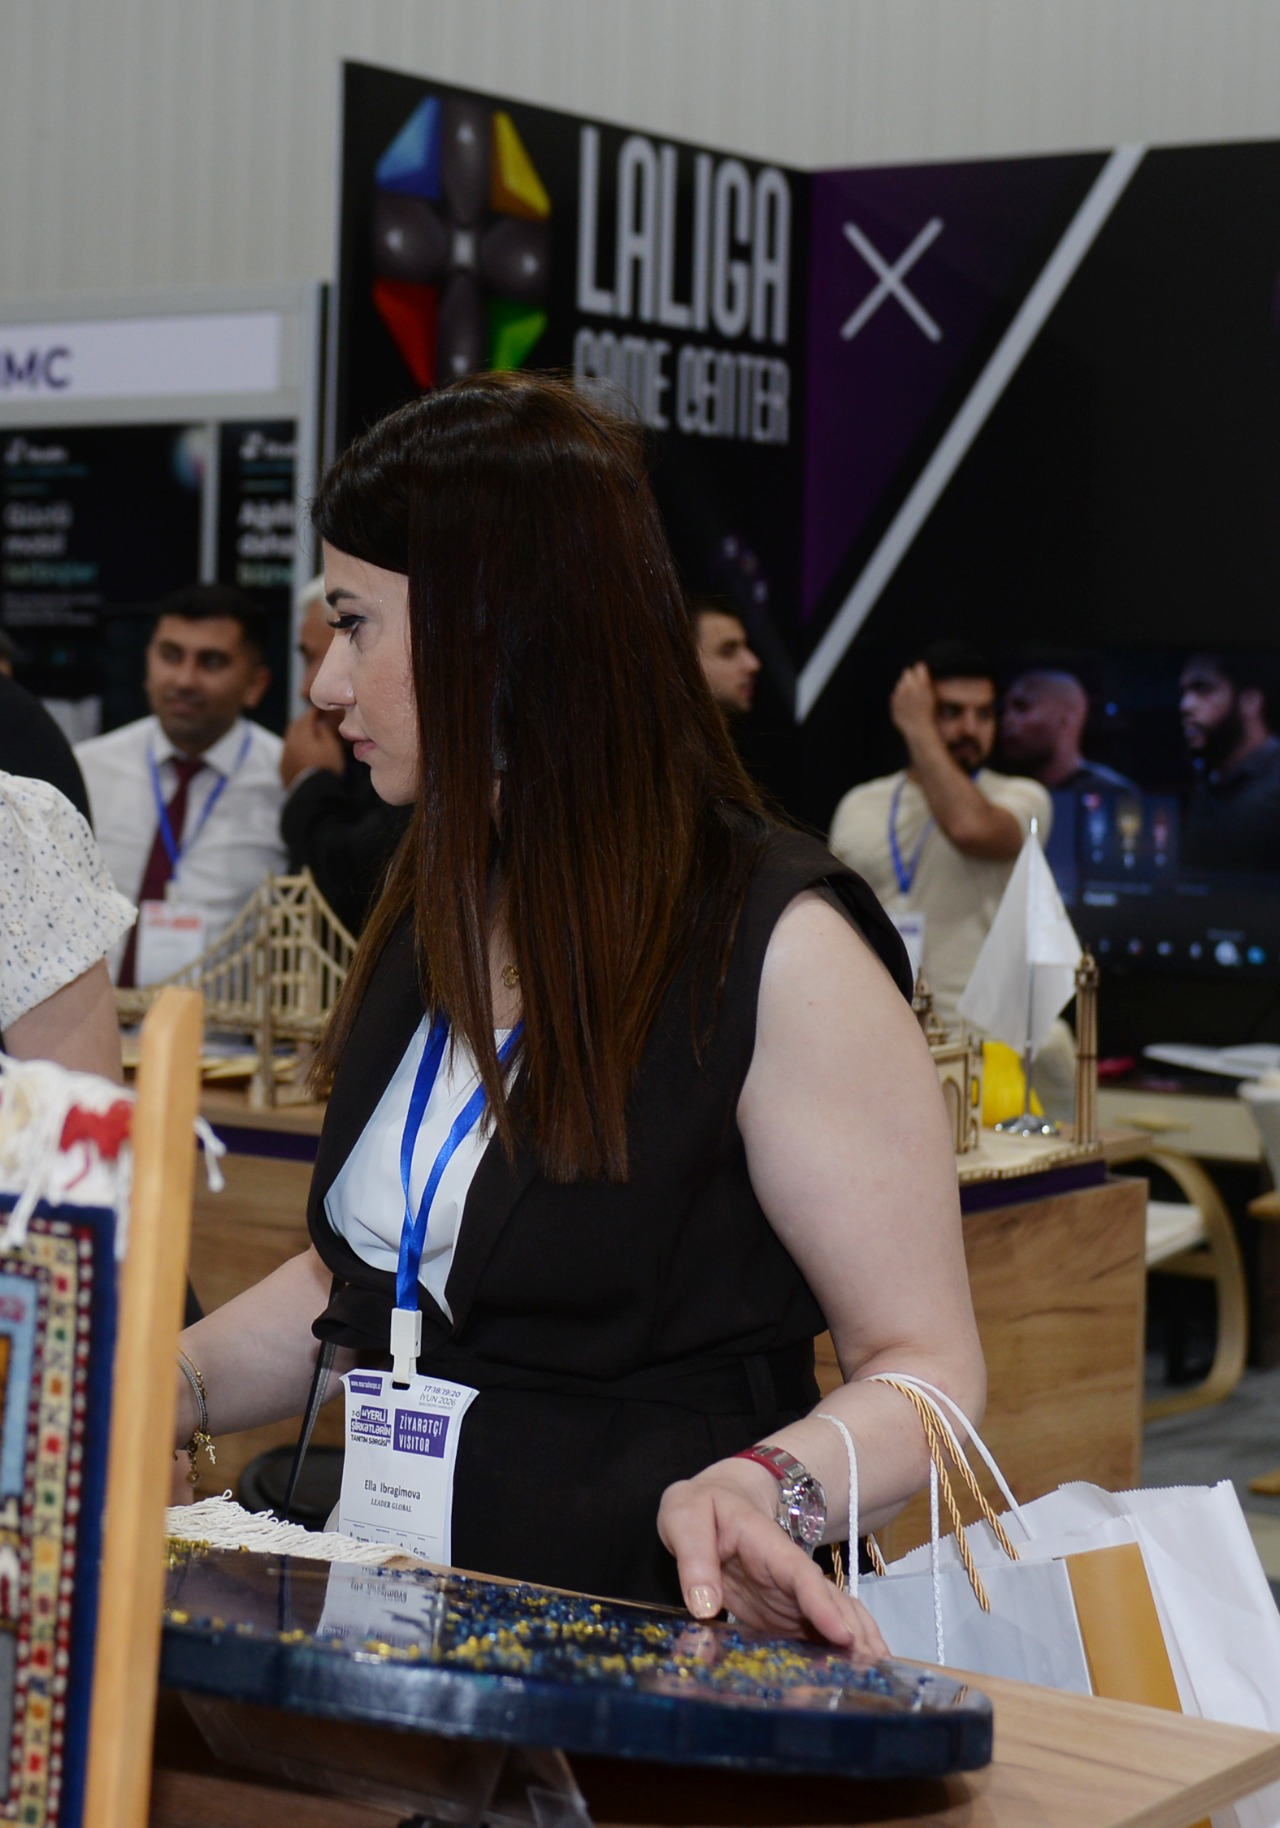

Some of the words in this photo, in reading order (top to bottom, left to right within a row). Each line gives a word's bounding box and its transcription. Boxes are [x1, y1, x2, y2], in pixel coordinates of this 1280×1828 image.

[576, 126, 791, 345] LALIGA
[677, 344, 790, 446] CENTER
[439, 1394, 457, 1407] 2026
[399, 1412, 444, 1438] ZİYARƏTÇİ
[398, 1433, 431, 1454] VISITOR
[364, 1479, 377, 1492] Ella
[380, 1482, 421, 1500] Ibragimova
[370, 1498, 391, 1509] LEADER
[391, 1502, 412, 1513] GLOBAL
